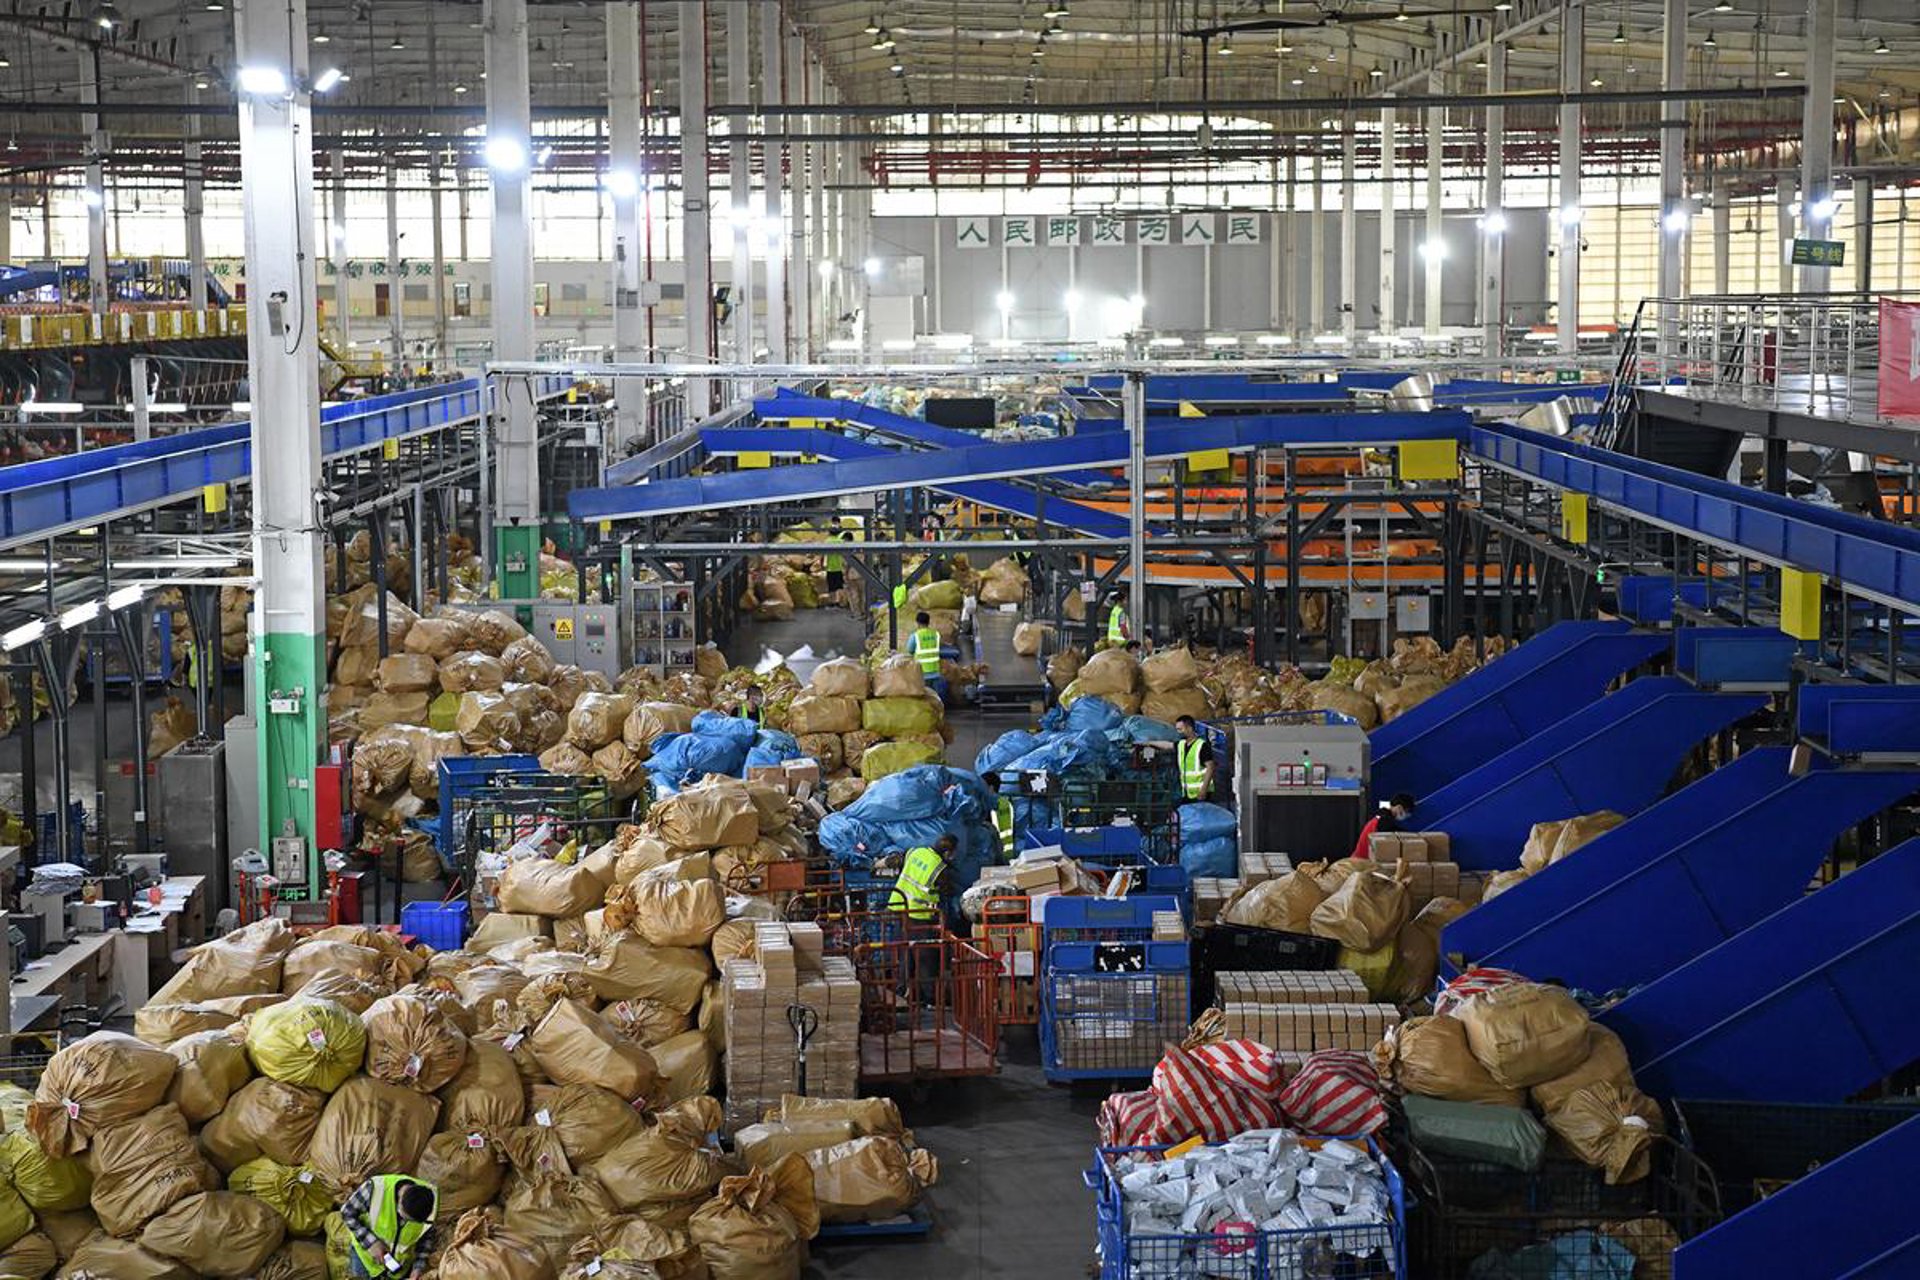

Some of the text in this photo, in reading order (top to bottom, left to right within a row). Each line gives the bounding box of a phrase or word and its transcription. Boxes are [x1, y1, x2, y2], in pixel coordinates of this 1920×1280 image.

[959, 217, 1258, 243] 人民邮政为人民
[1795, 246, 1841, 261] 三号线
